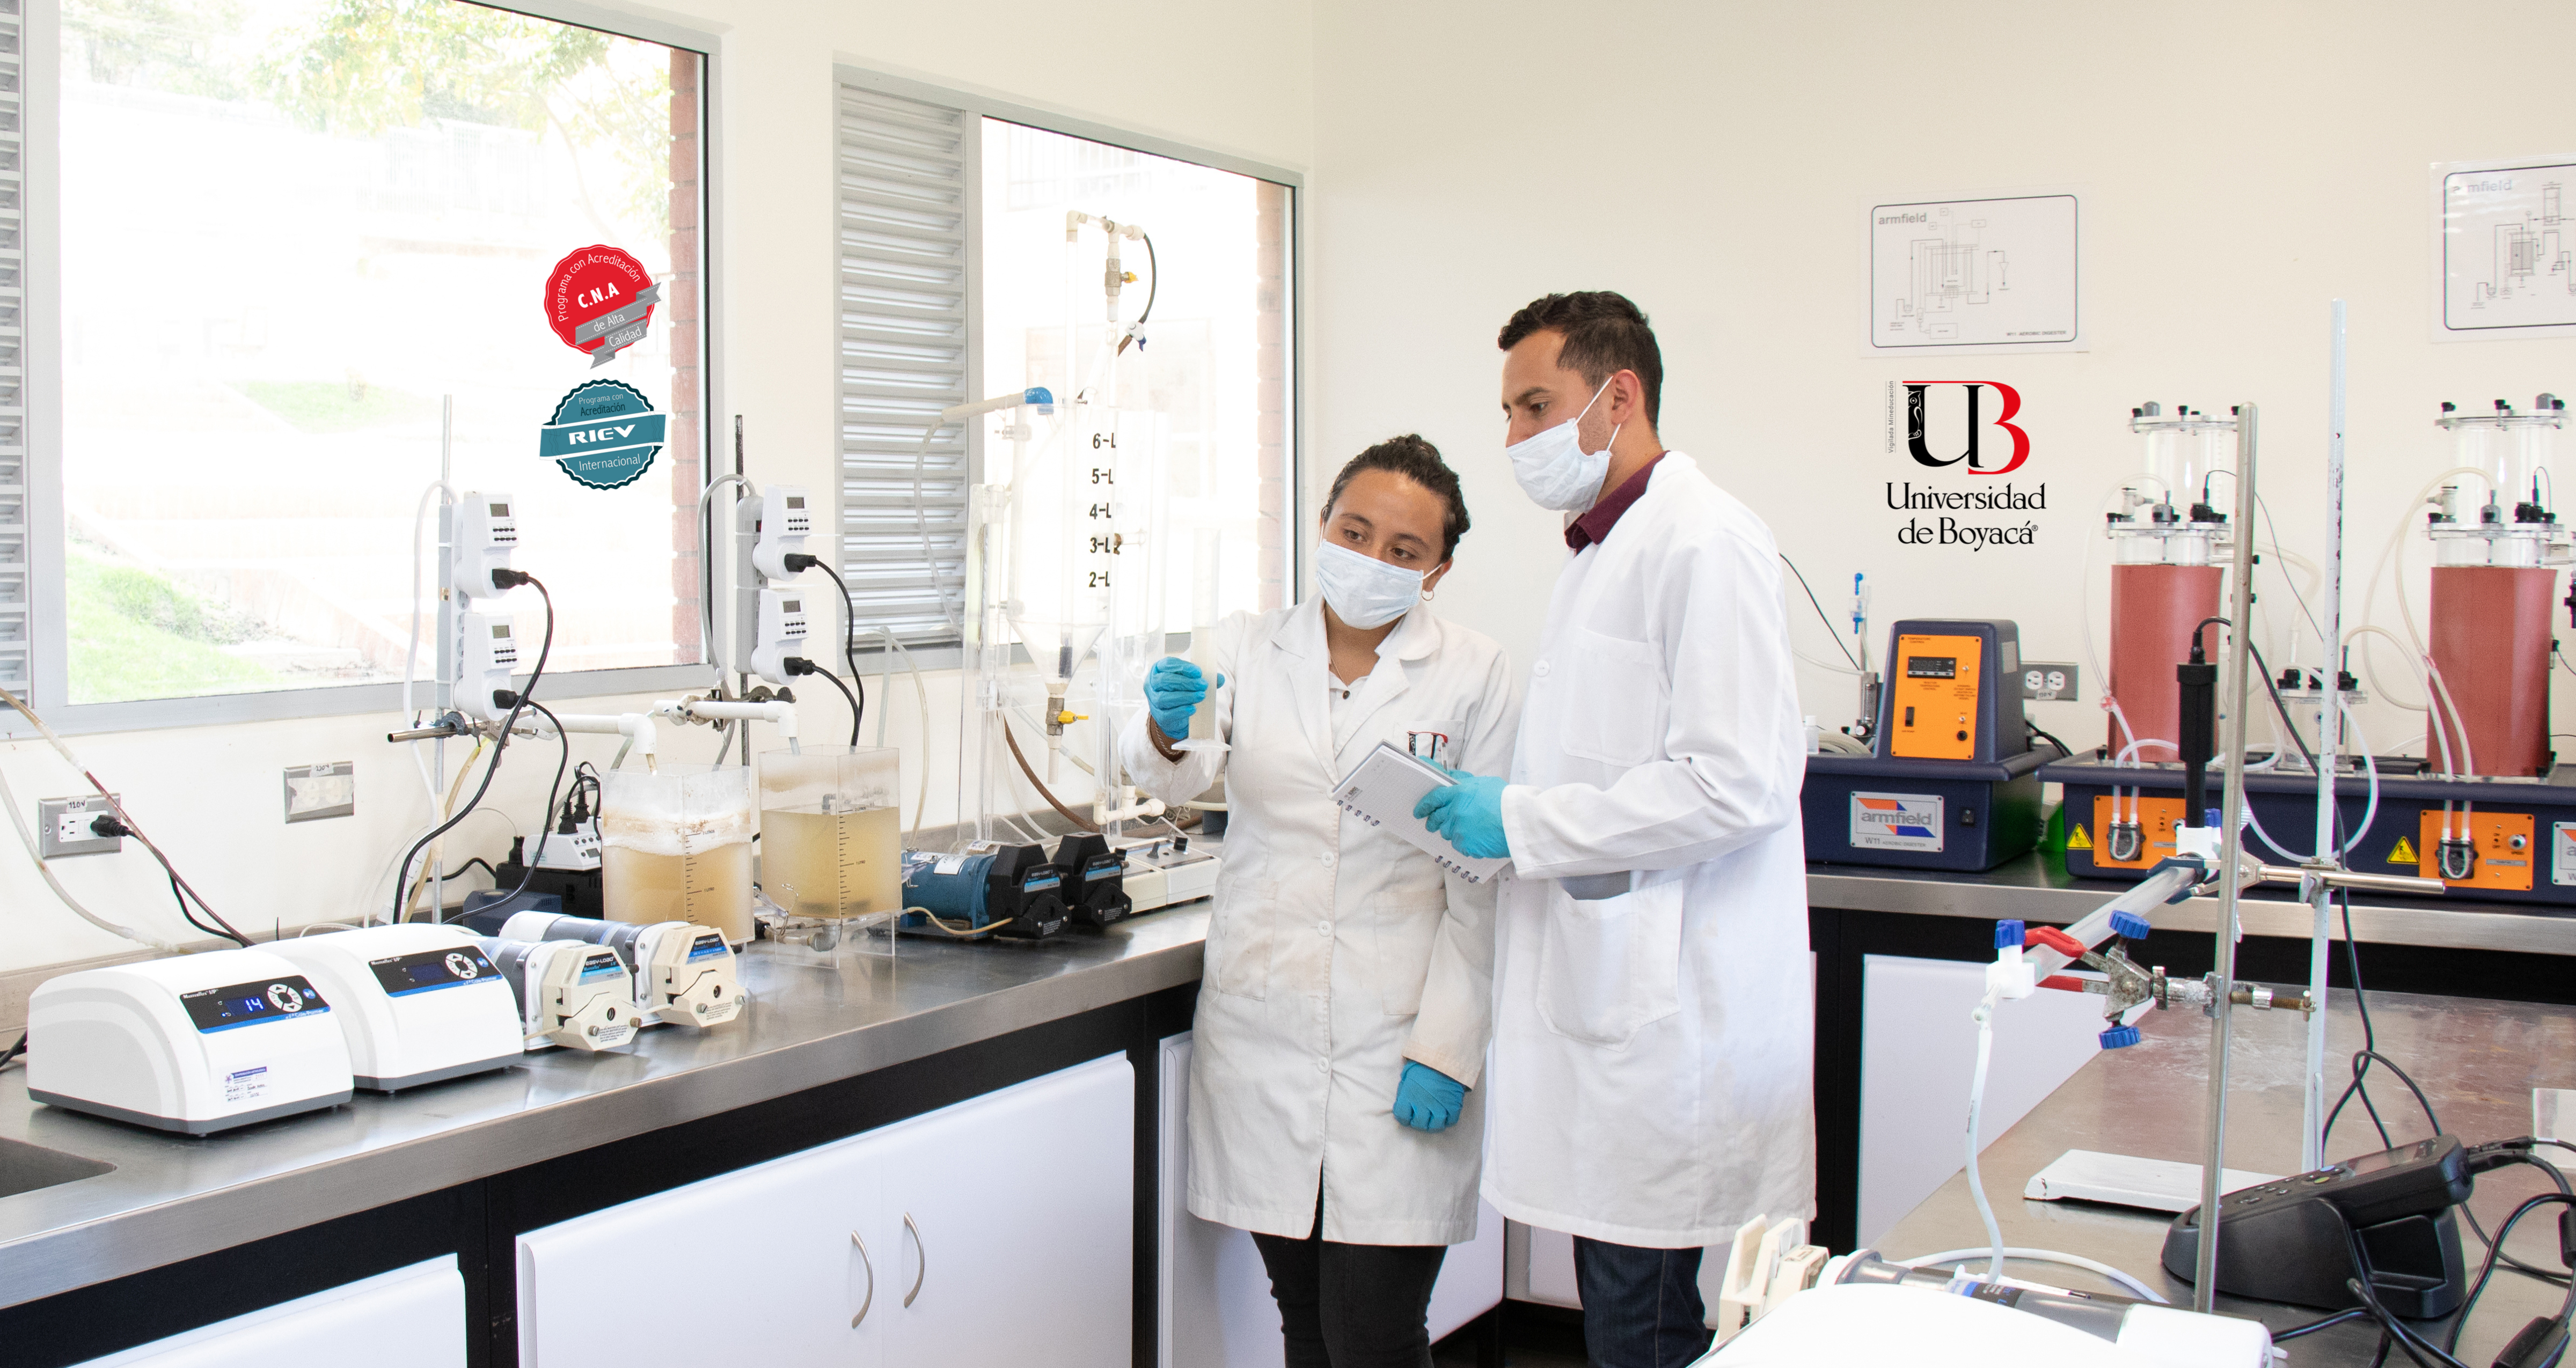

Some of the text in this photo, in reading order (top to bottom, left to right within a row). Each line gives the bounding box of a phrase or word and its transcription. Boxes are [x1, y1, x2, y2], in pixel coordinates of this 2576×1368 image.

[1878, 213, 1927, 225] armfield
[69, 800, 85, 808] 110V
[1861, 812, 1931, 825] armfield
[246, 997, 264, 1012] 14
